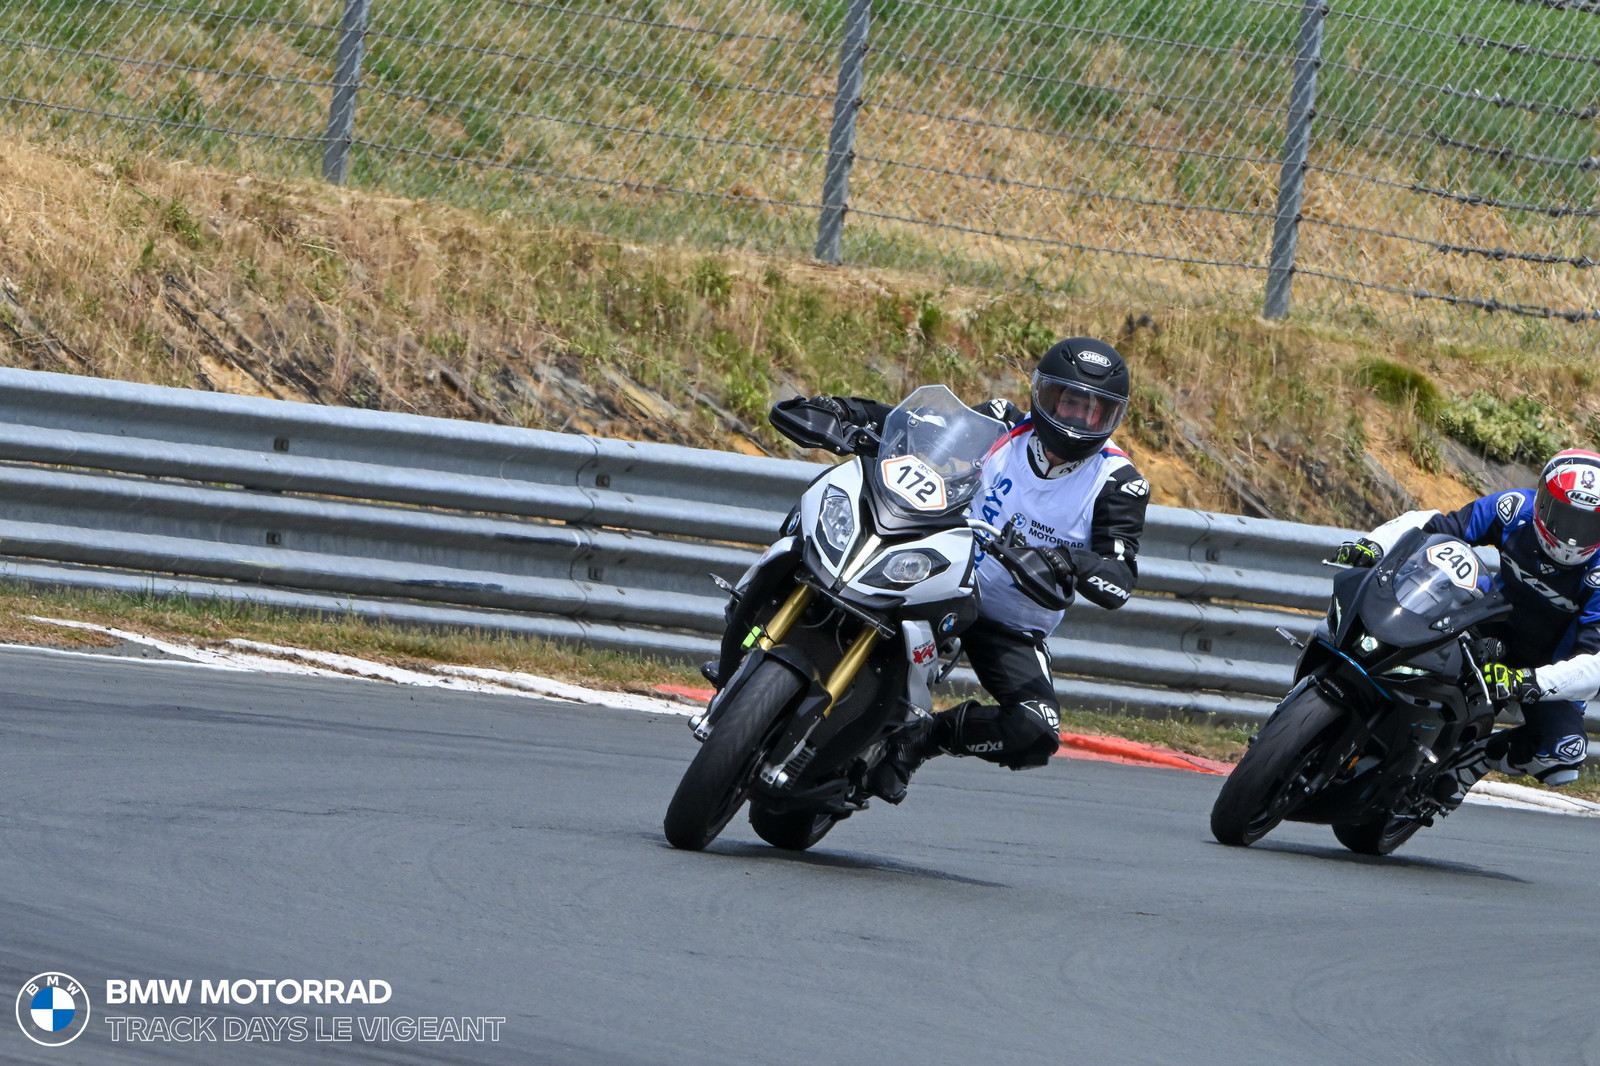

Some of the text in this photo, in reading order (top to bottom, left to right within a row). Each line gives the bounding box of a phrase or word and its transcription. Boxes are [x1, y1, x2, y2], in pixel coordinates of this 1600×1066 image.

[1082, 352, 1107, 365] SHOEI
[896, 465, 937, 503] 172
[1569, 491, 1599, 504] HJC
[1031, 519, 1055, 535] BMW
[1028, 527, 1084, 549] MOTORRAD
[1435, 546, 1472, 580] 240
